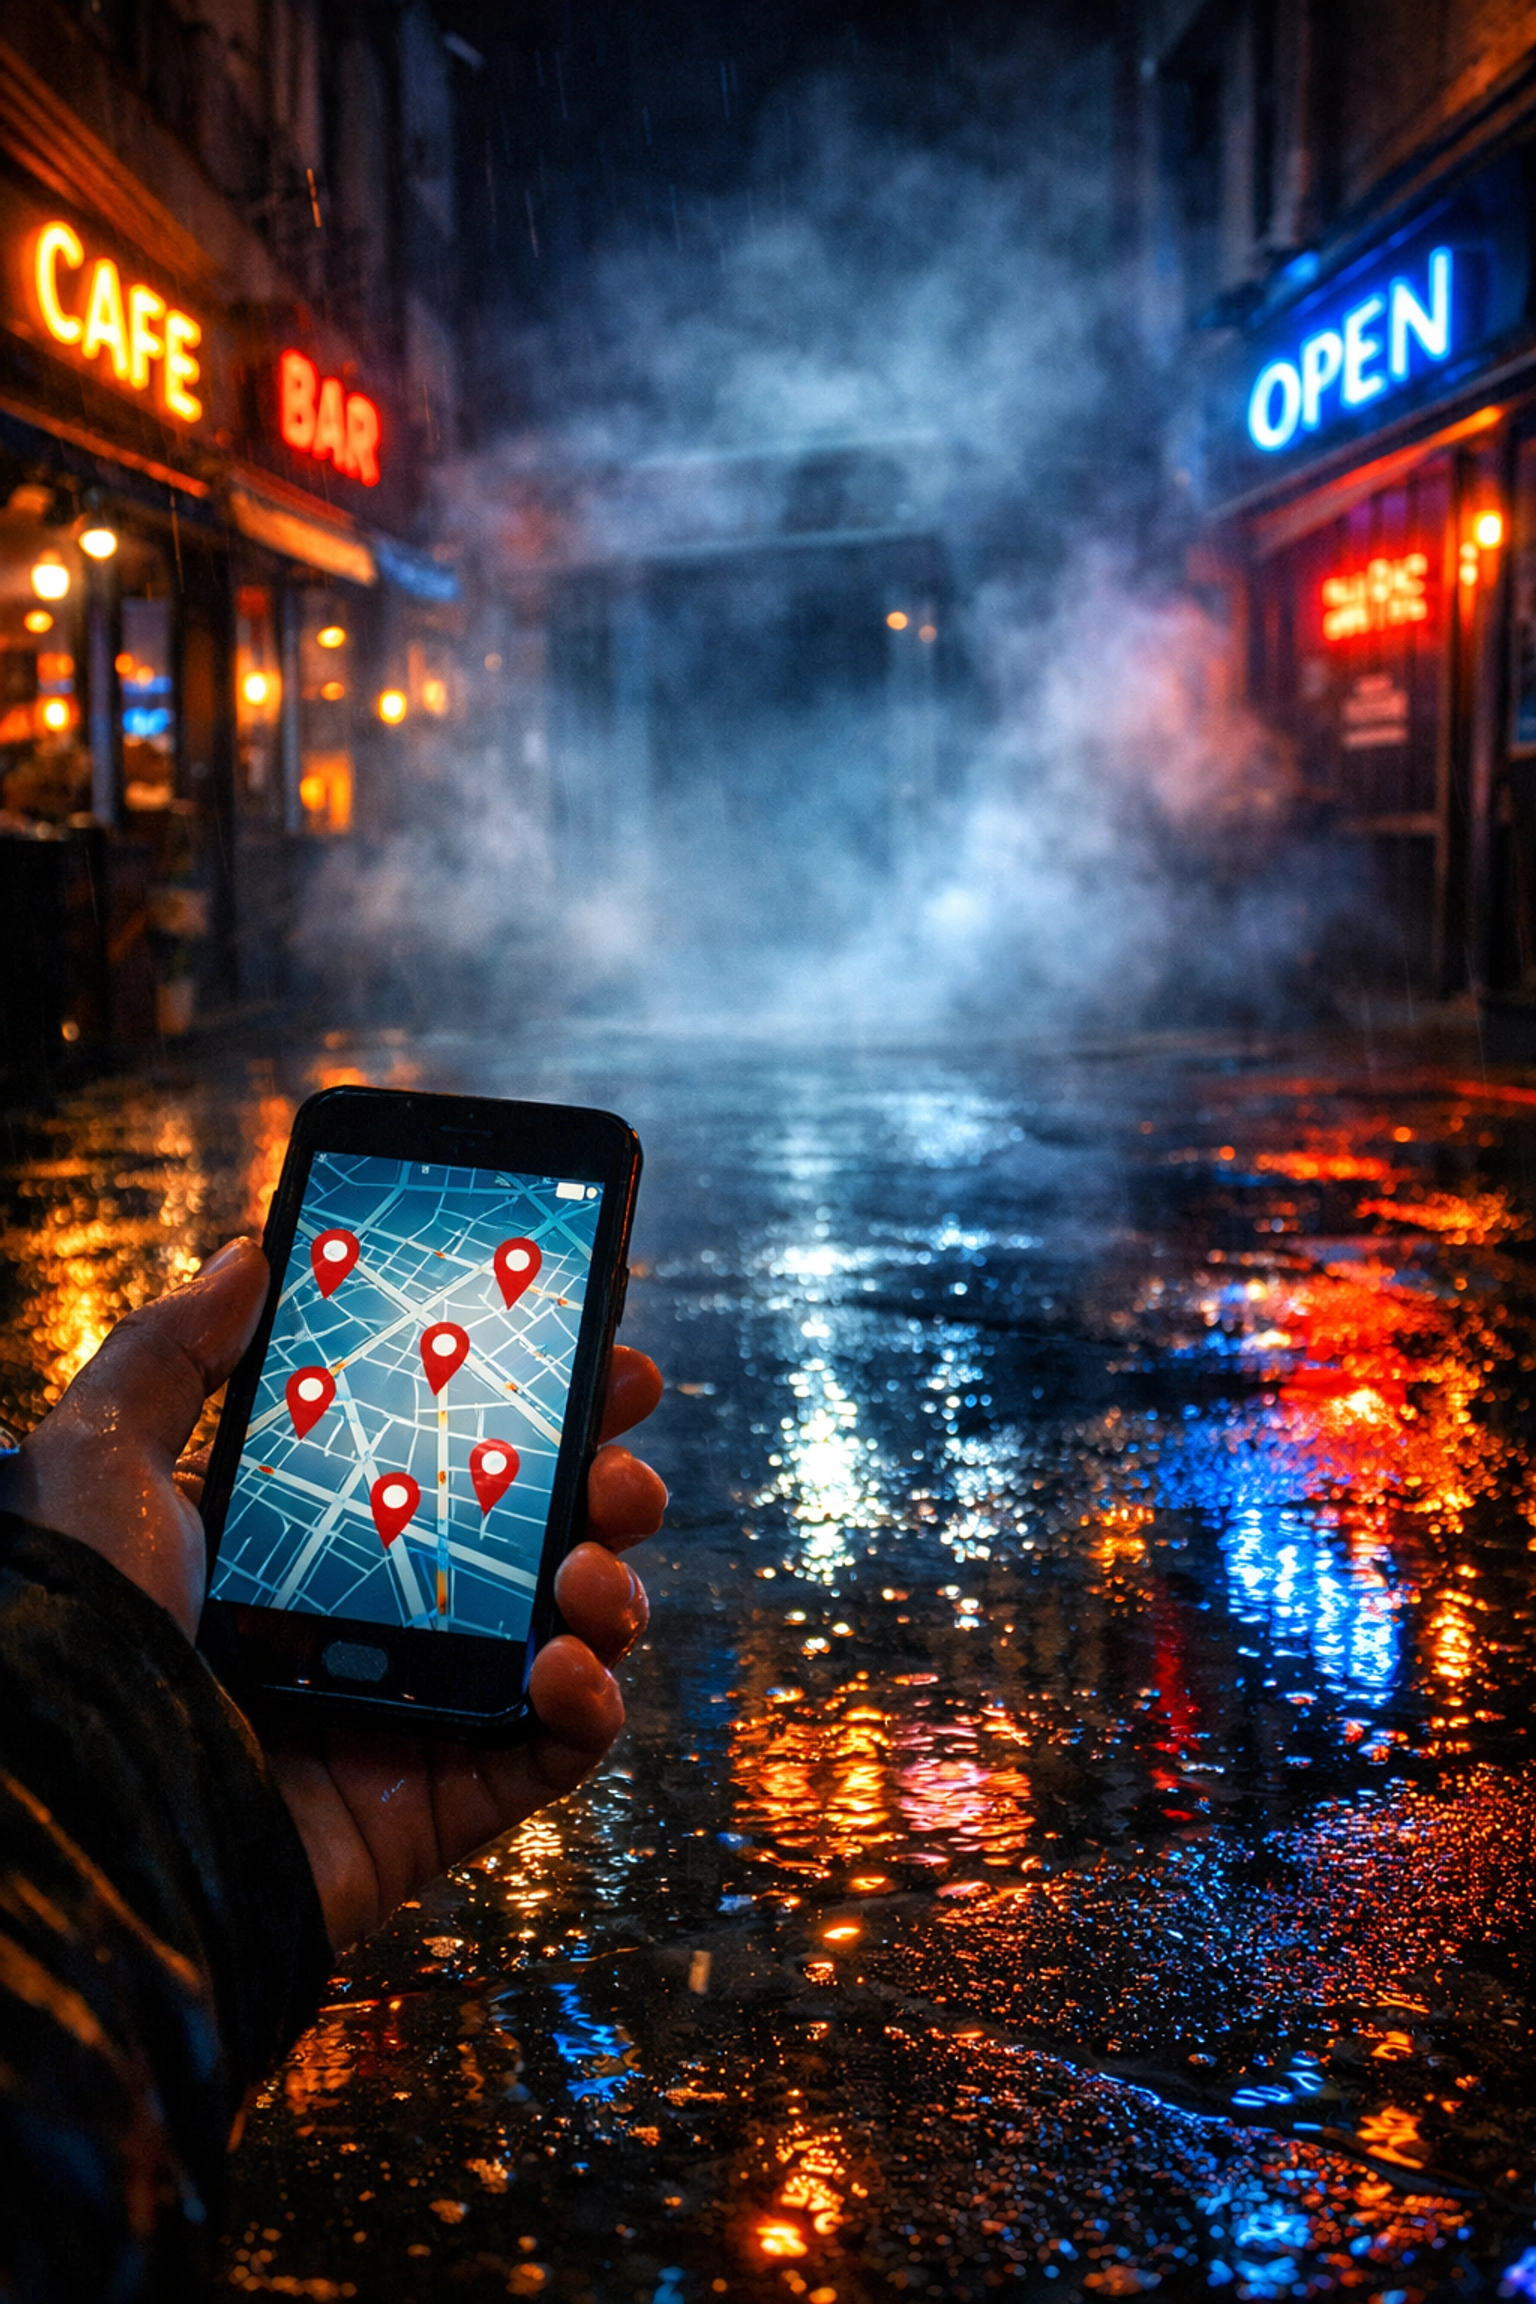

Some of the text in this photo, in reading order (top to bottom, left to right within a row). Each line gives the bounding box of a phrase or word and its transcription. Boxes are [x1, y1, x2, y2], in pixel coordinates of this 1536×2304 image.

[35, 220, 202, 423] CAFE
[280, 348, 382, 488] BAR
[1248, 246, 1453, 451] OPEN
